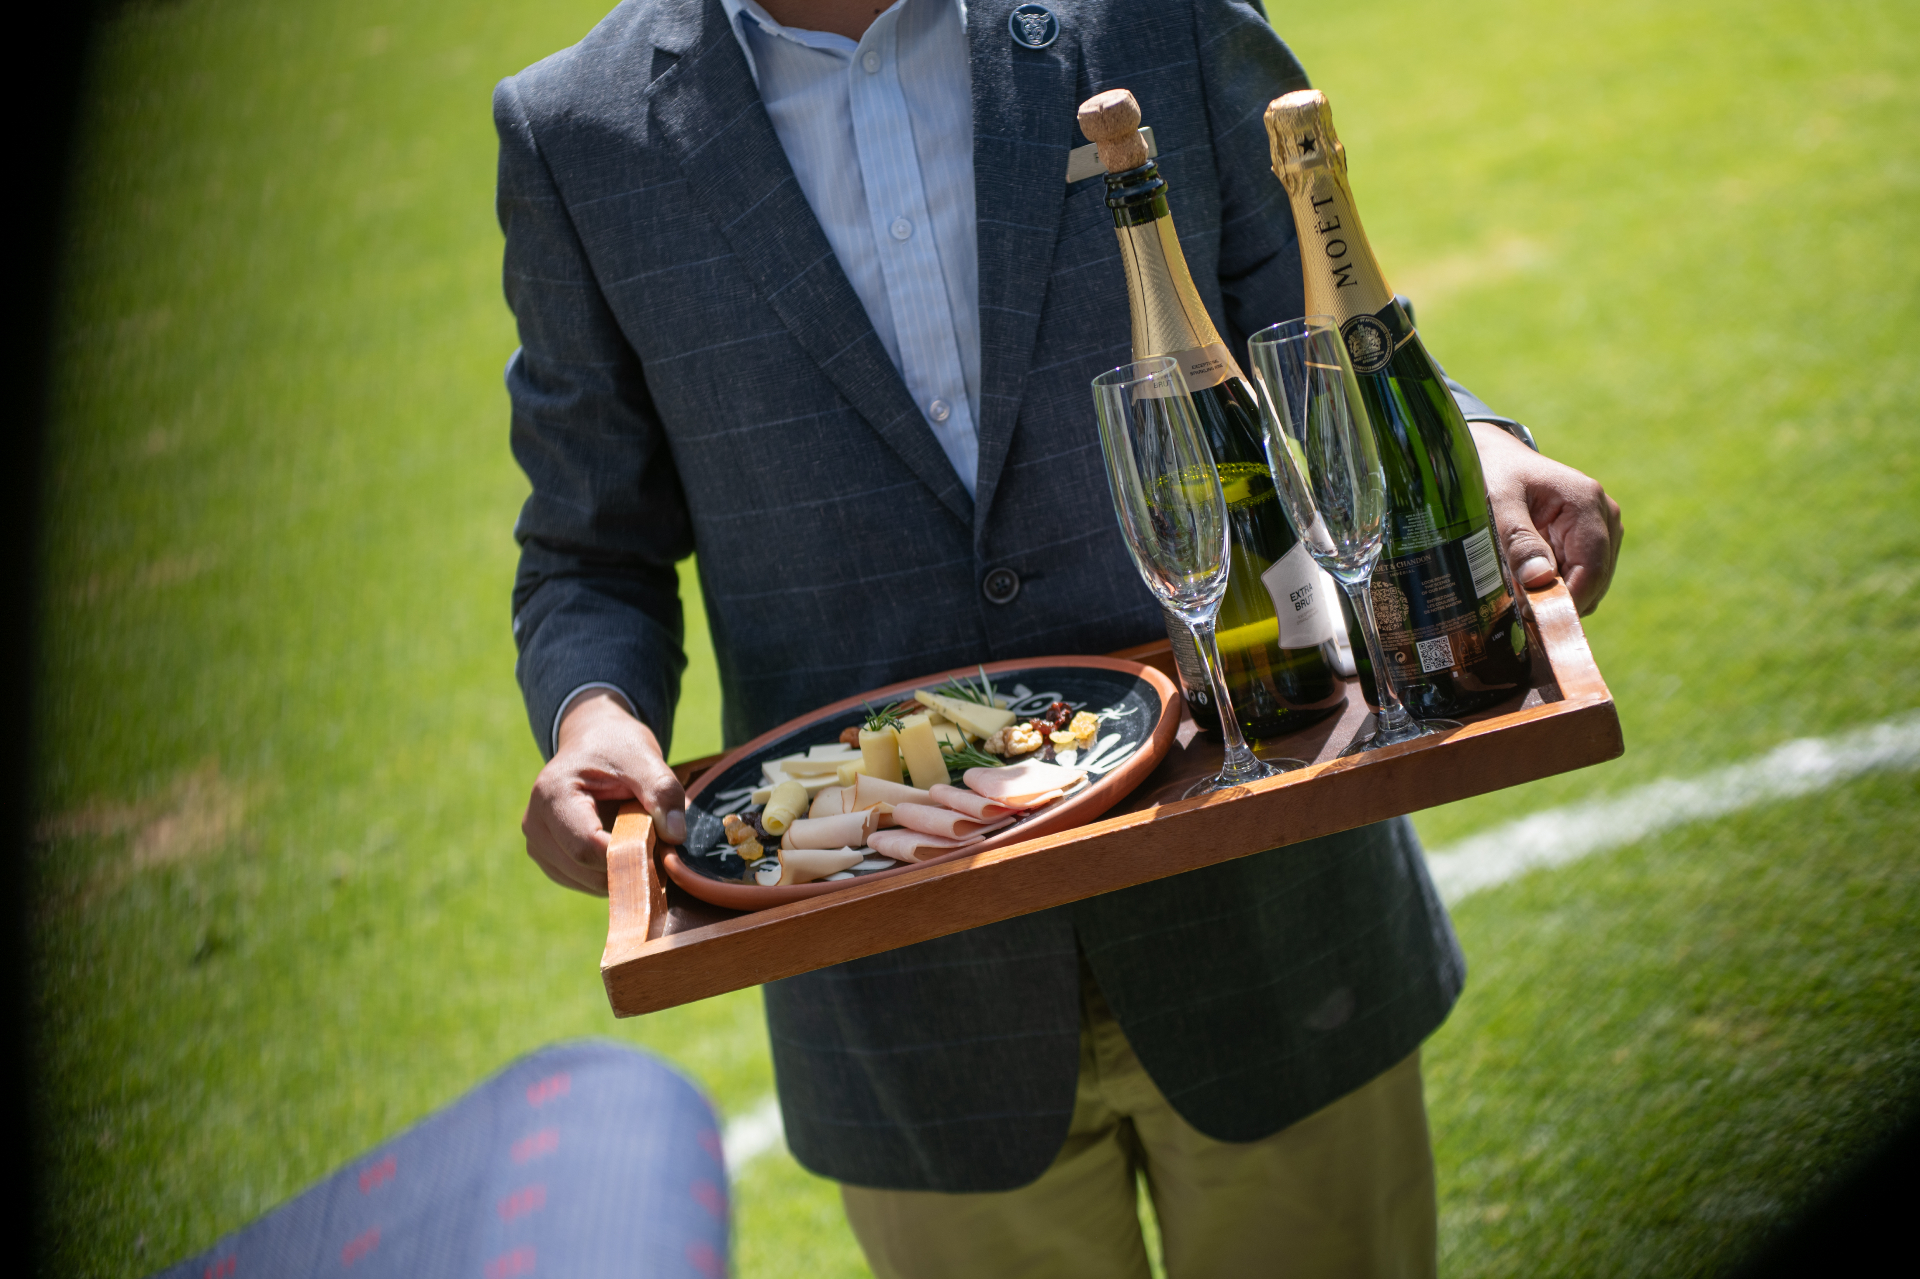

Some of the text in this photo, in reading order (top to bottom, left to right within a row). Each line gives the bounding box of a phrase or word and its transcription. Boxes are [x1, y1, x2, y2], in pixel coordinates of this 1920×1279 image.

[1311, 195, 1357, 289] MOËT
[1396, 554, 1431, 568] CHANDON
[1289, 582, 1313, 602] EXTRA
[1294, 594, 1314, 612] BRUT
